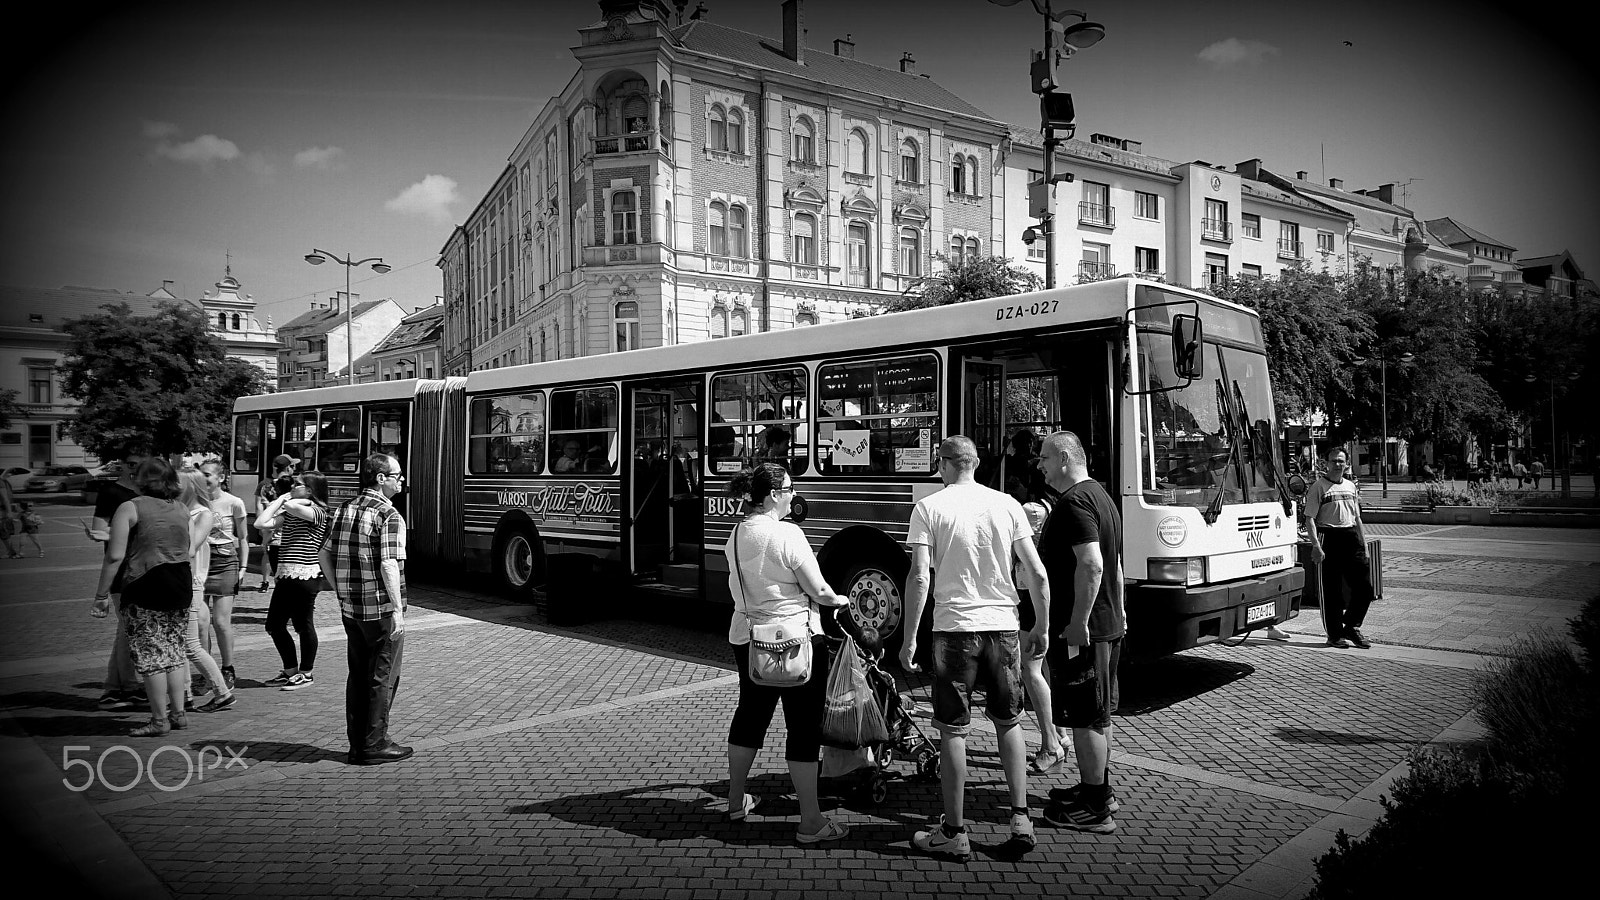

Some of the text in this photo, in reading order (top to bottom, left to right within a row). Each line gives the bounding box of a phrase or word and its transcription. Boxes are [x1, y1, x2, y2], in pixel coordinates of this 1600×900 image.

[996, 300, 1059, 321] DZA-027
[497, 488, 528, 506] VÁROSI
[708, 497, 745, 516] BUSZ
